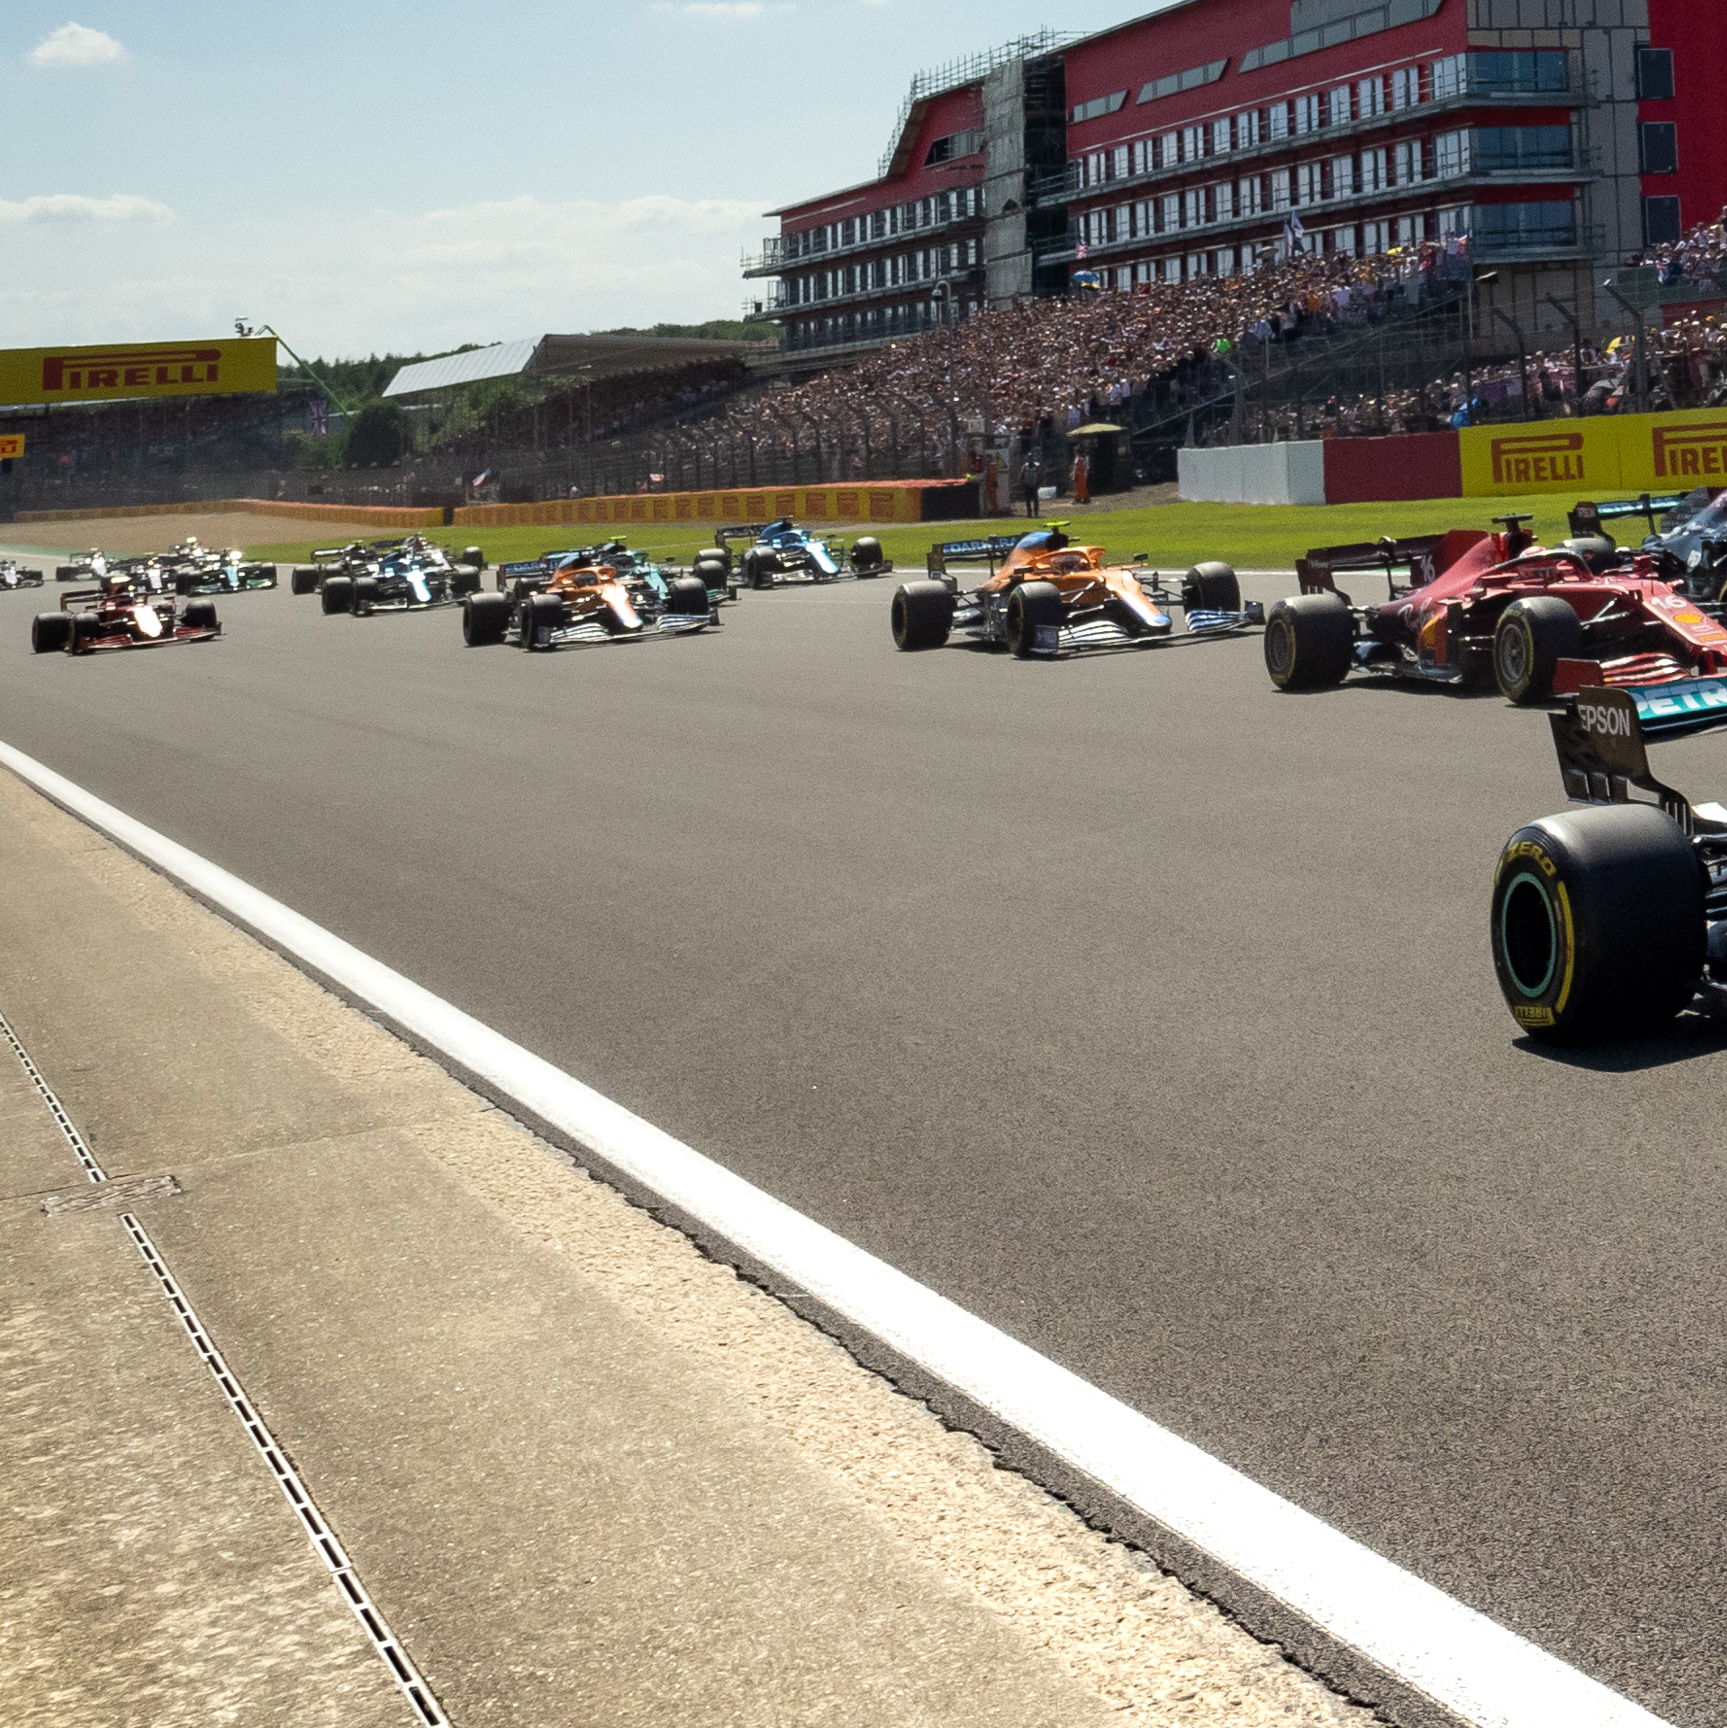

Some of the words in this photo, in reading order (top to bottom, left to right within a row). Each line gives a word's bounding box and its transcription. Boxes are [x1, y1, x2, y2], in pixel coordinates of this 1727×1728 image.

[42, 349, 222, 391] PIRELLI
[1490, 432, 1584, 484] PIRELLI
[1650, 594, 1688, 610] 16
[1578, 704, 1631, 737] EPSON
